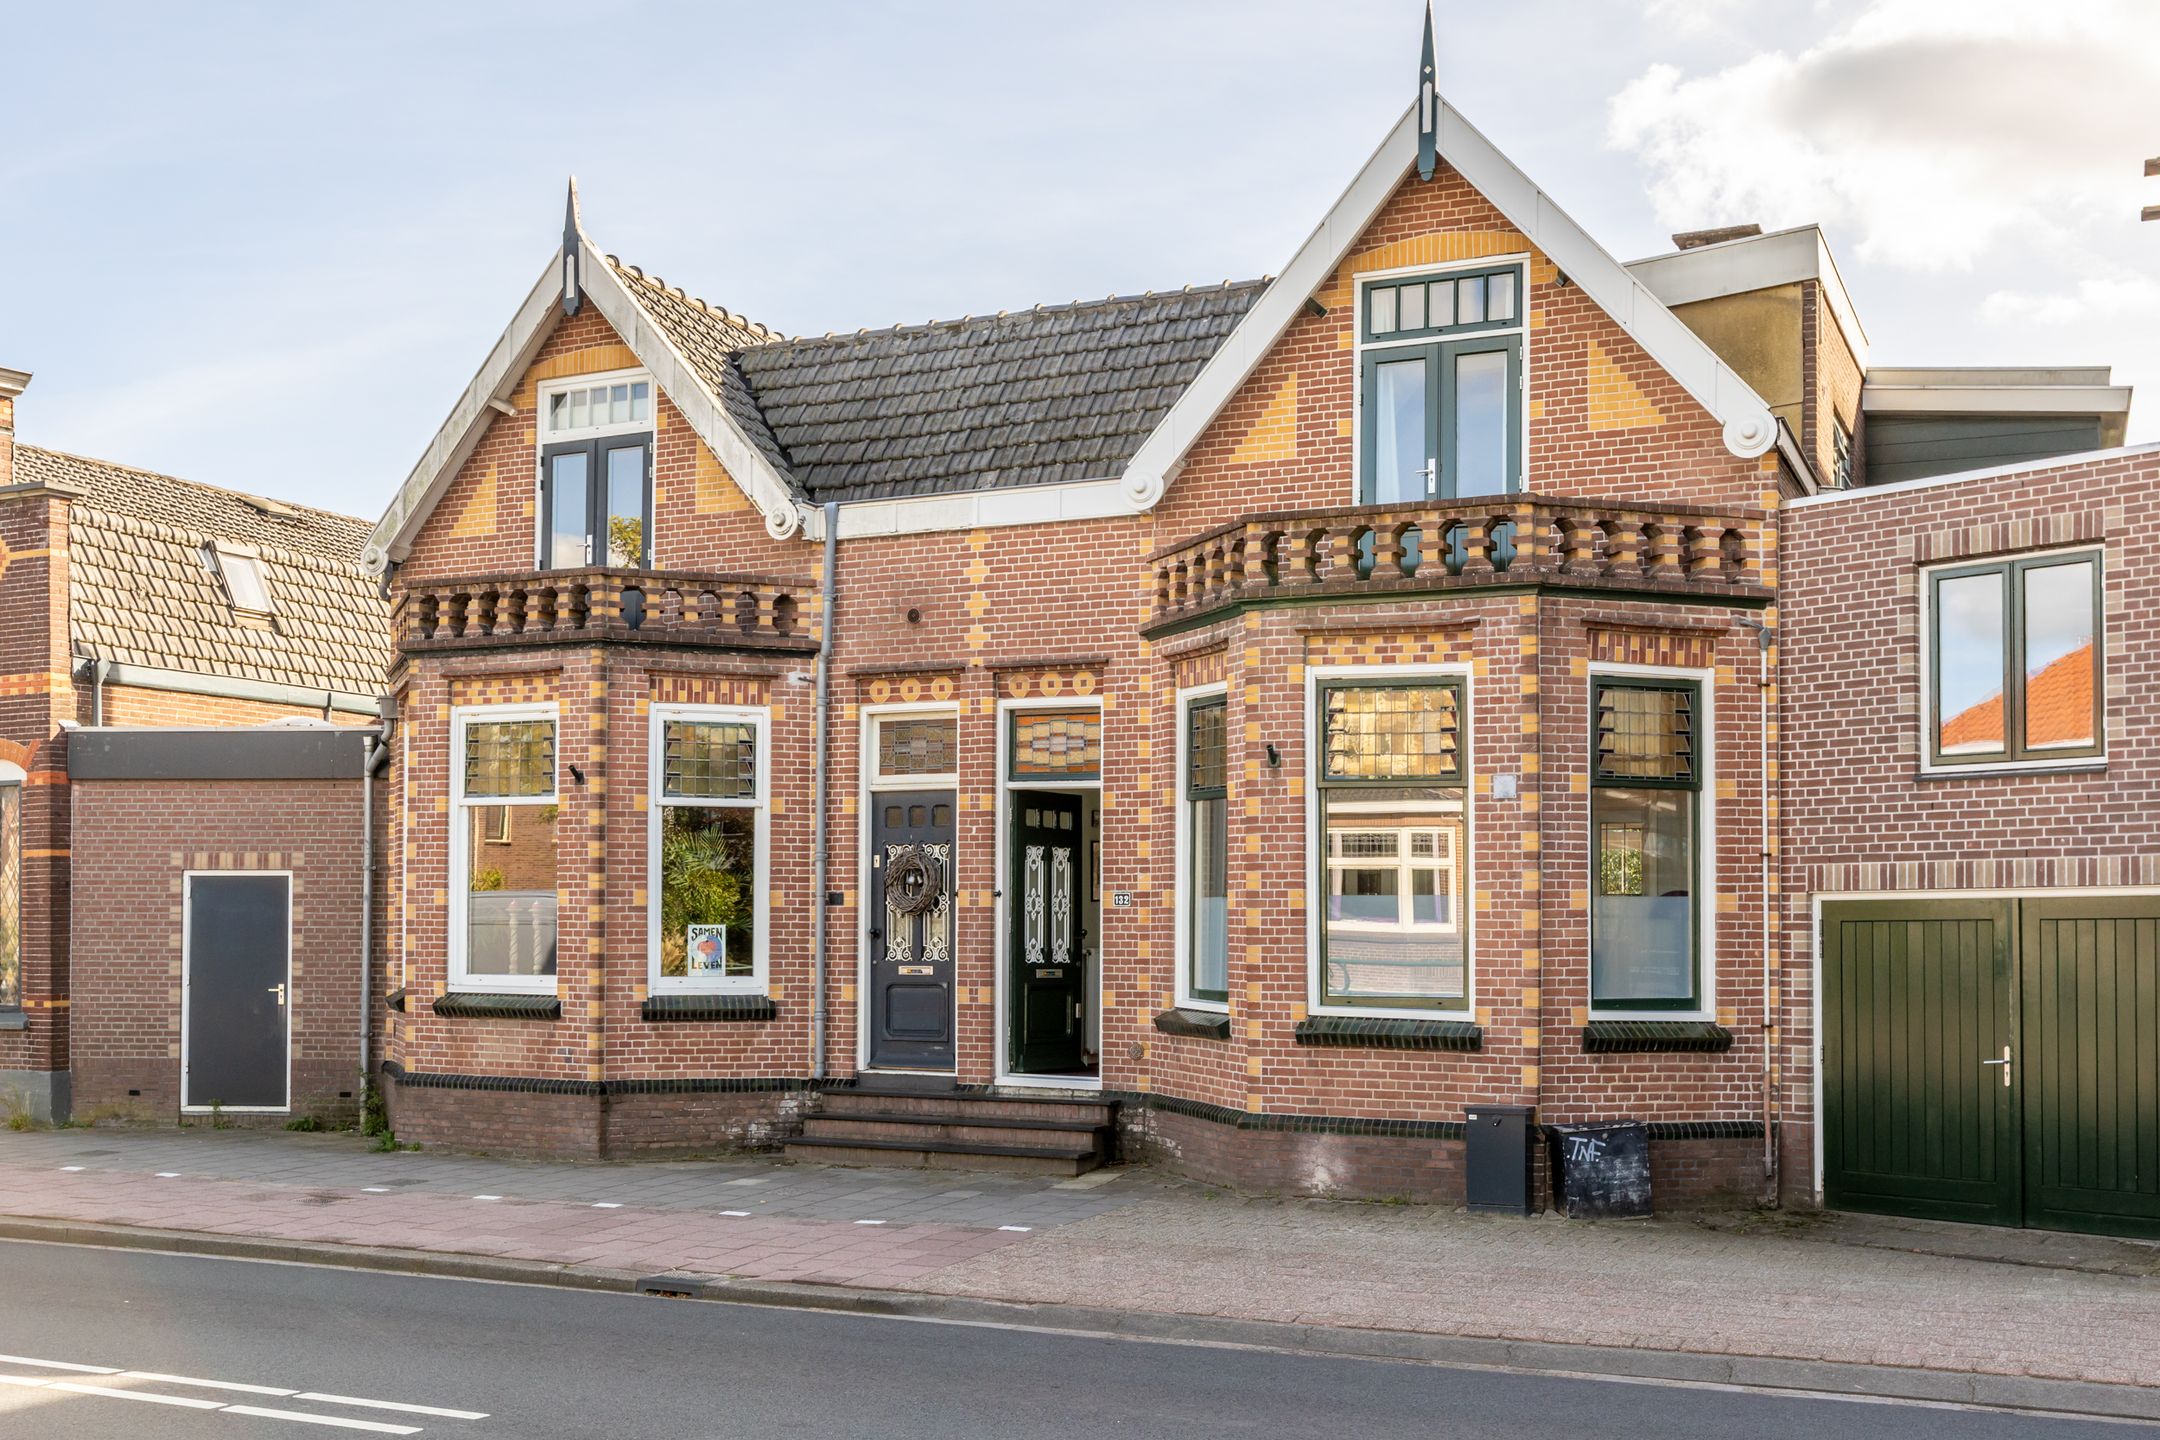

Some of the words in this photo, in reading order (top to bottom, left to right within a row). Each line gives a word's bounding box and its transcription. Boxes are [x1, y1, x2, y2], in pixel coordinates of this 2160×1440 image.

[1115, 895, 1129, 905] 132
[691, 927, 723, 941] SAMEN
[691, 956, 723, 970] LEVEN
